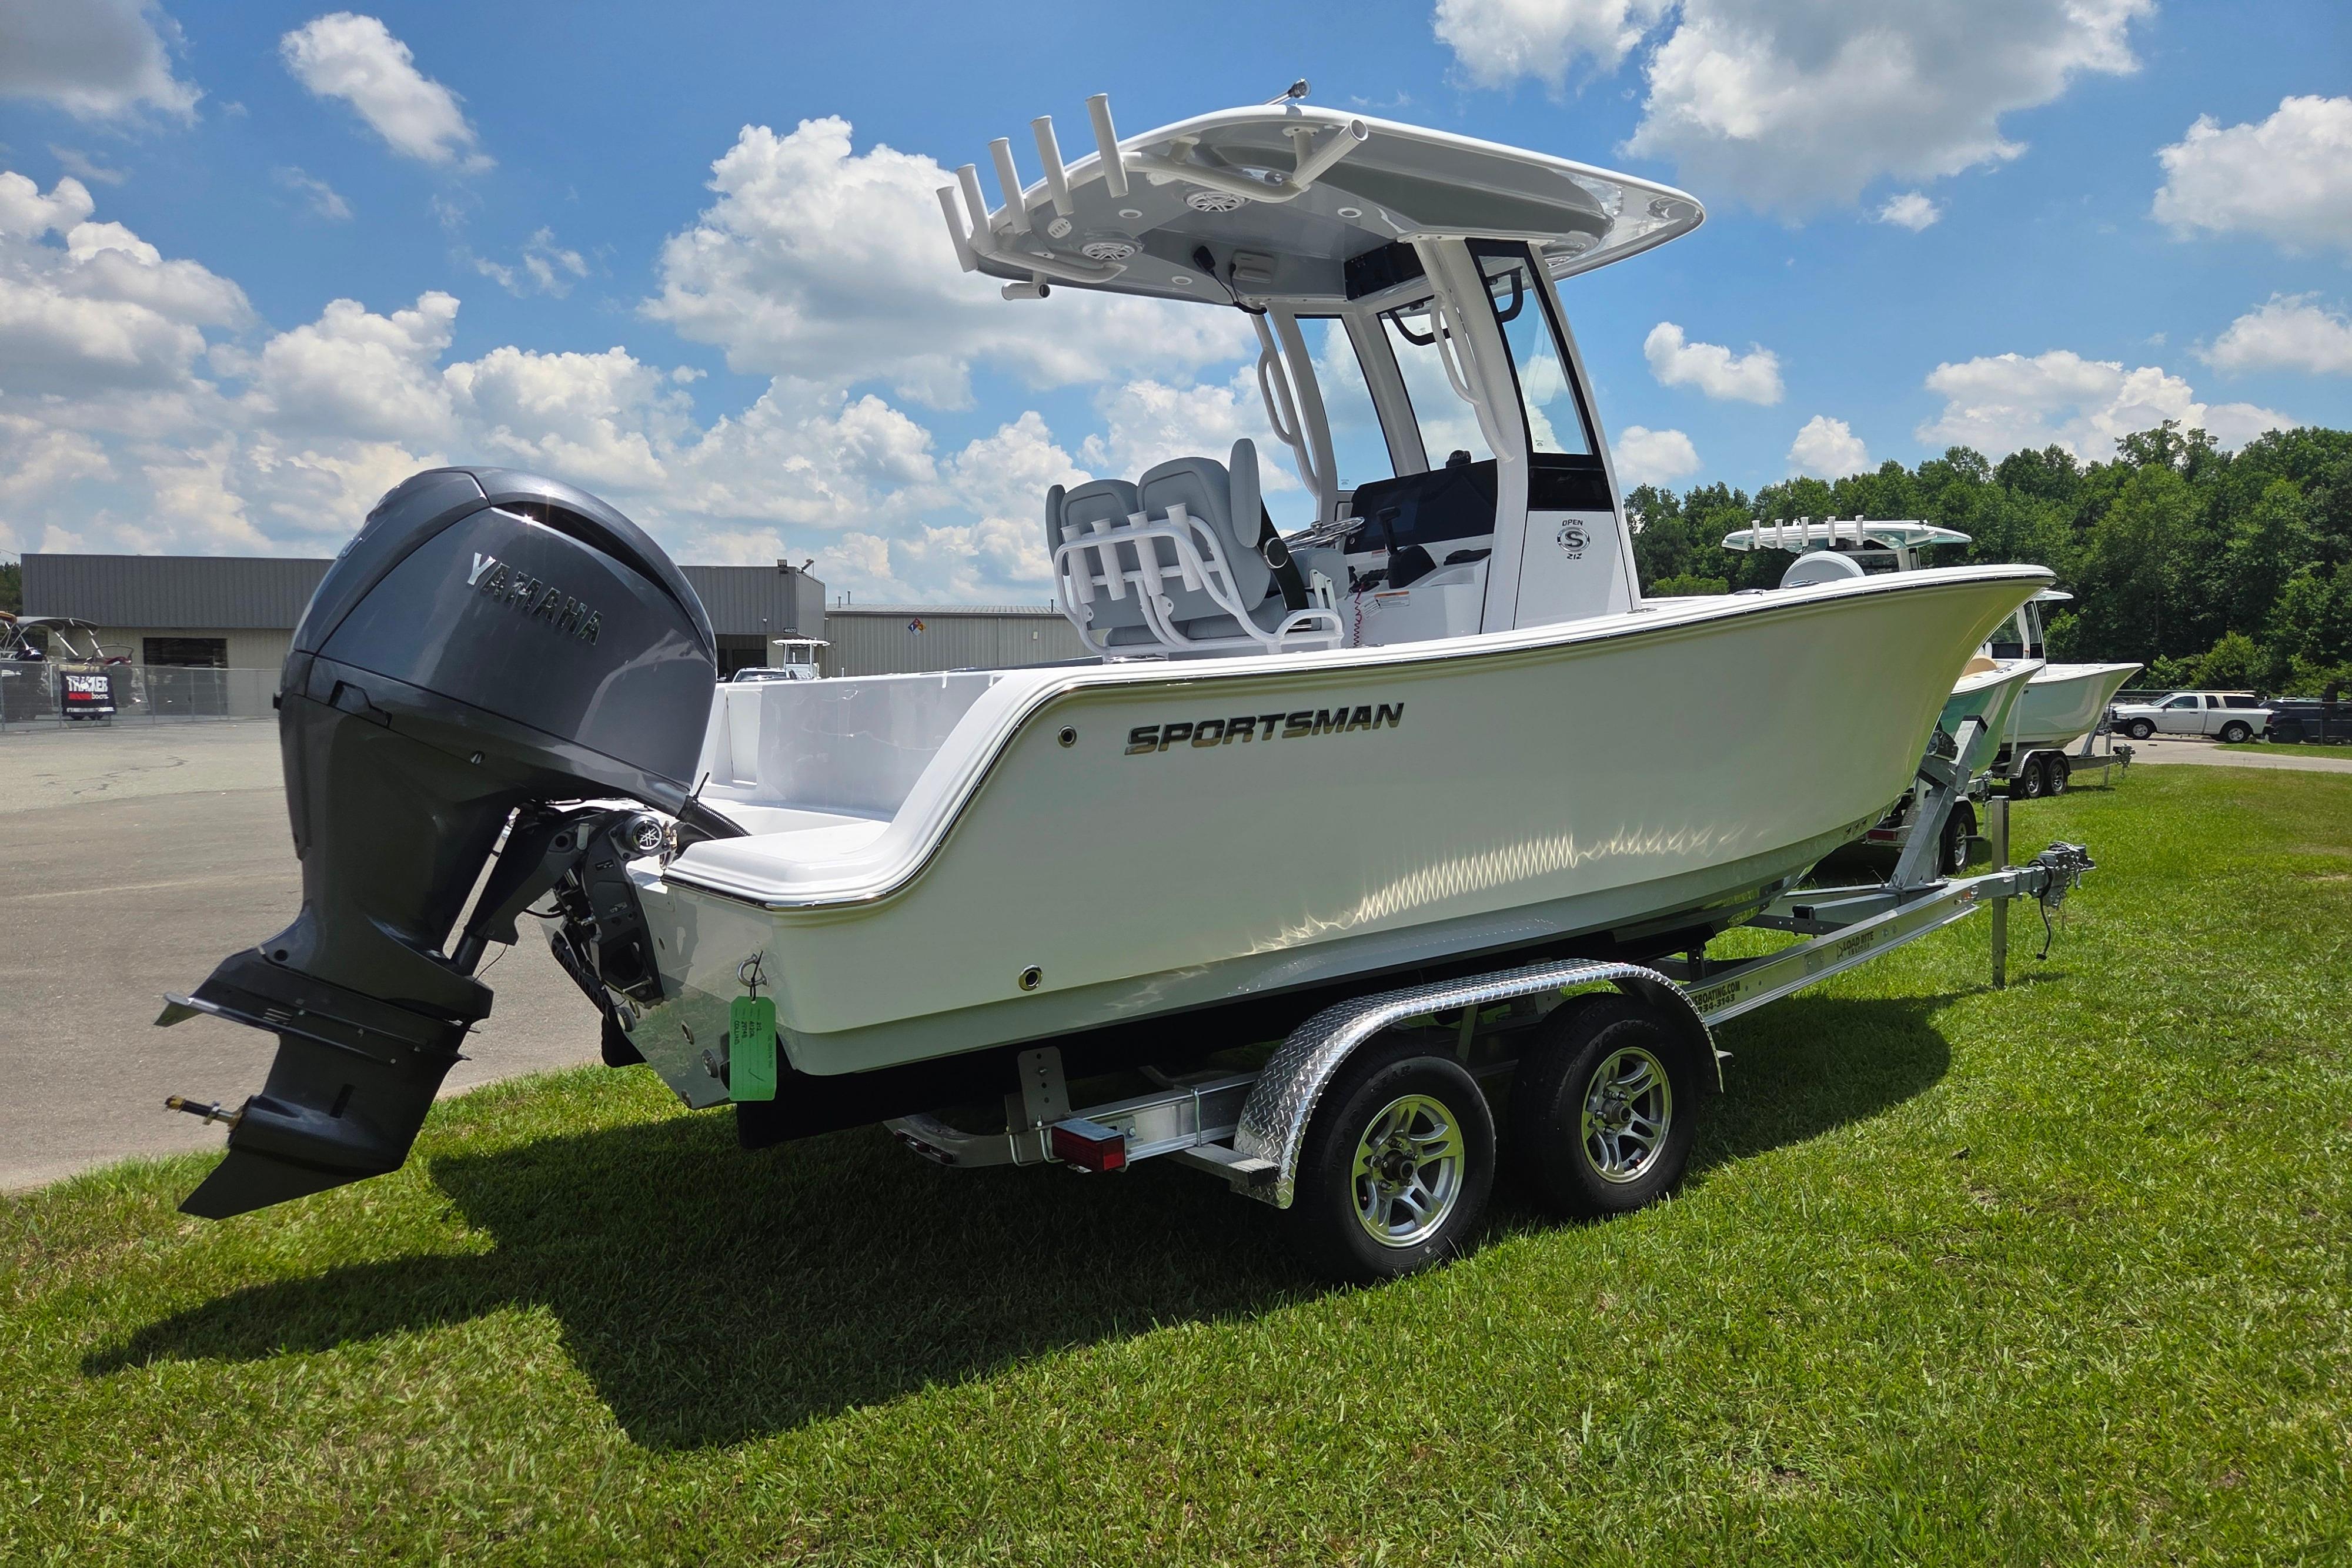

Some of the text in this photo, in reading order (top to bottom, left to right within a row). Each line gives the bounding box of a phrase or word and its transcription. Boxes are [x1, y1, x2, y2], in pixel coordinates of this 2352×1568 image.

[1562, 519, 1583, 527] OPEN
[467, 552, 603, 646] YAMAHA
[1124, 702, 1405, 755] SPORTSMAN
